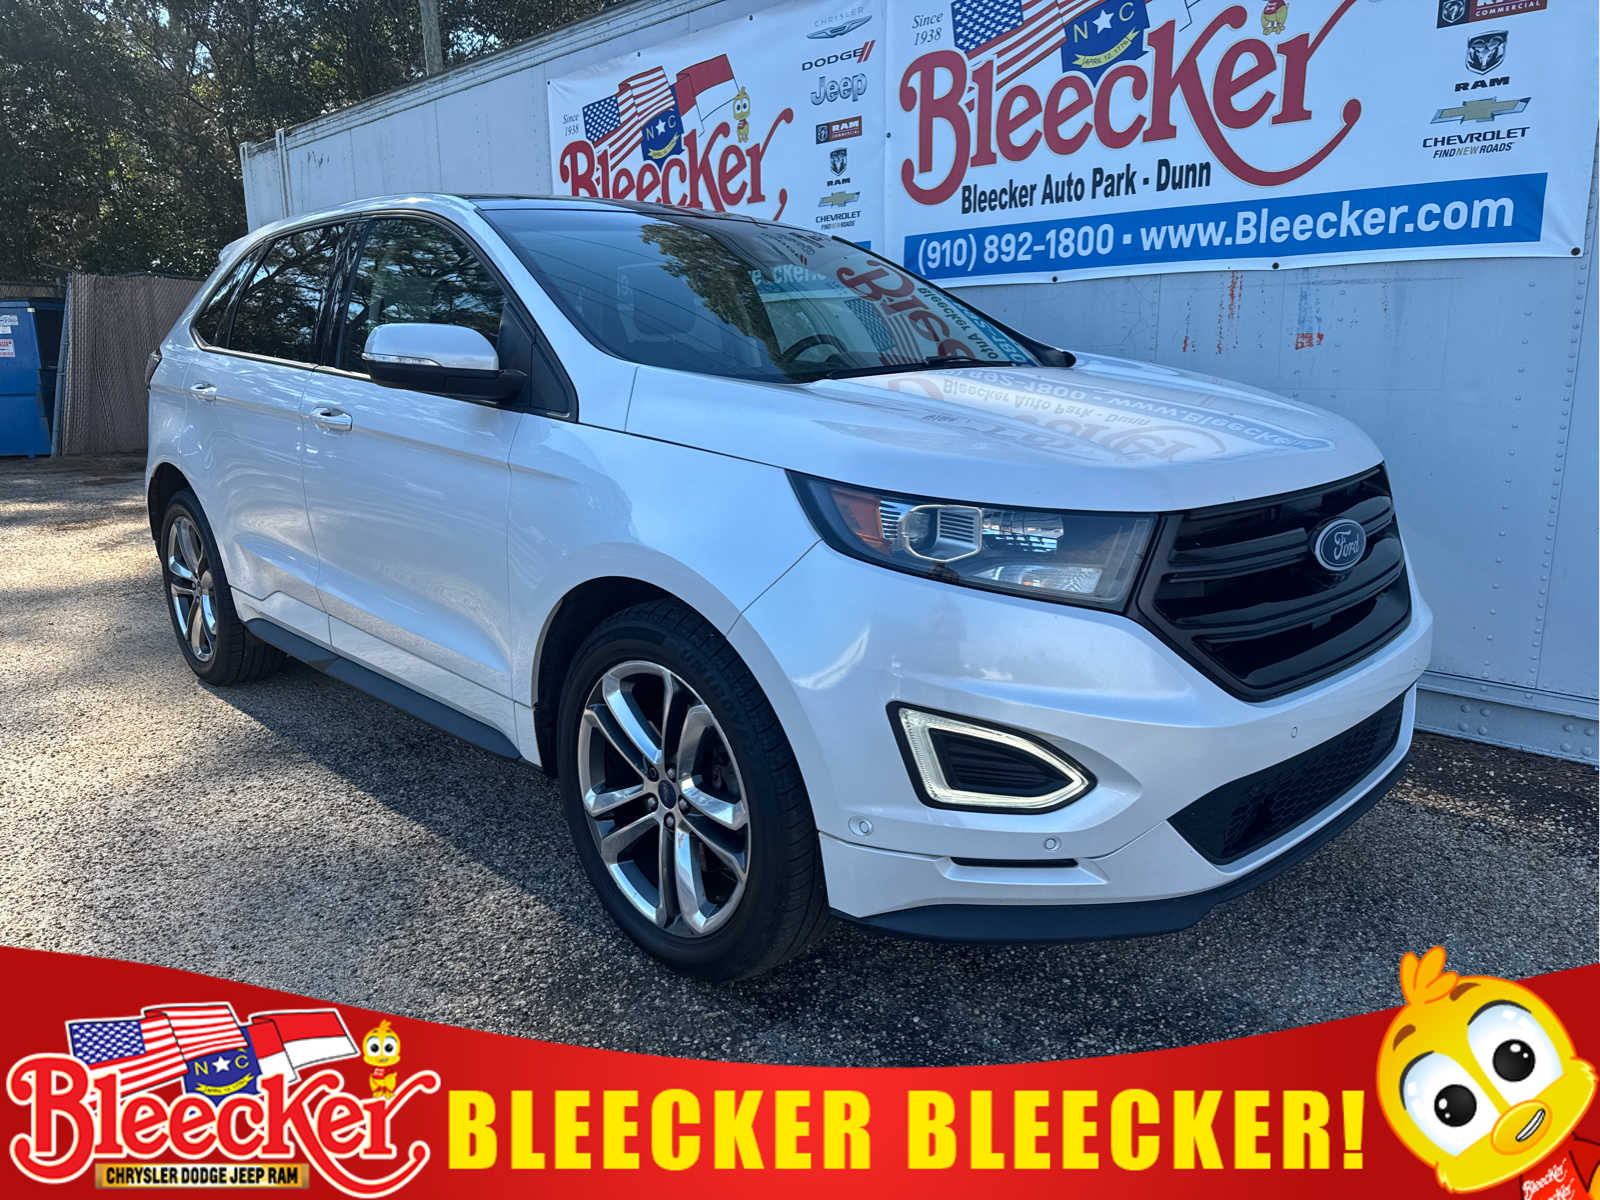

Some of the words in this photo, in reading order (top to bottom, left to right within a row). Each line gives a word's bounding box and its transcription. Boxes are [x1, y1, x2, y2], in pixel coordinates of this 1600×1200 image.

[911, 11, 944, 29] Since
[1475, 0, 1542, 17] COMMERCIAL
[1073, 21, 1089, 43] N
[1118, 1, 1136, 23] C
[913, 28, 942, 46] 1938
[801, 46, 864, 71] DODGE
[811, 72, 868, 106] Jeep
[1454, 76, 1510, 92] RAM
[899, 0, 1363, 205] Bleecker
[645, 125, 655, 141] N
[667, 114, 677, 129] C
[831, 119, 860, 133] RAM
[1422, 126, 1531, 148] CHEVROLET
[1432, 147, 1456, 159] FIND
[1455, 145, 1480, 156] NEW
[1479, 142, 1513, 155] ROADS
[560, 107, 795, 221] Bleecker
[826, 178, 851, 187] RAM
[961, 179, 1037, 214] Bleecker
[1042, 171, 1085, 205] Auto
[1091, 164, 1137, 199] Park
[1156, 158, 1211, 192] Dunn
[815, 210, 861, 223] CHEVROLET
[917, 231, 977, 271] (910)
[983, 223, 1115, 264] 892-1800
[1140, 196, 1514, 251] www.Bleecker.com
[1333, 529, 1360, 561] Ford
